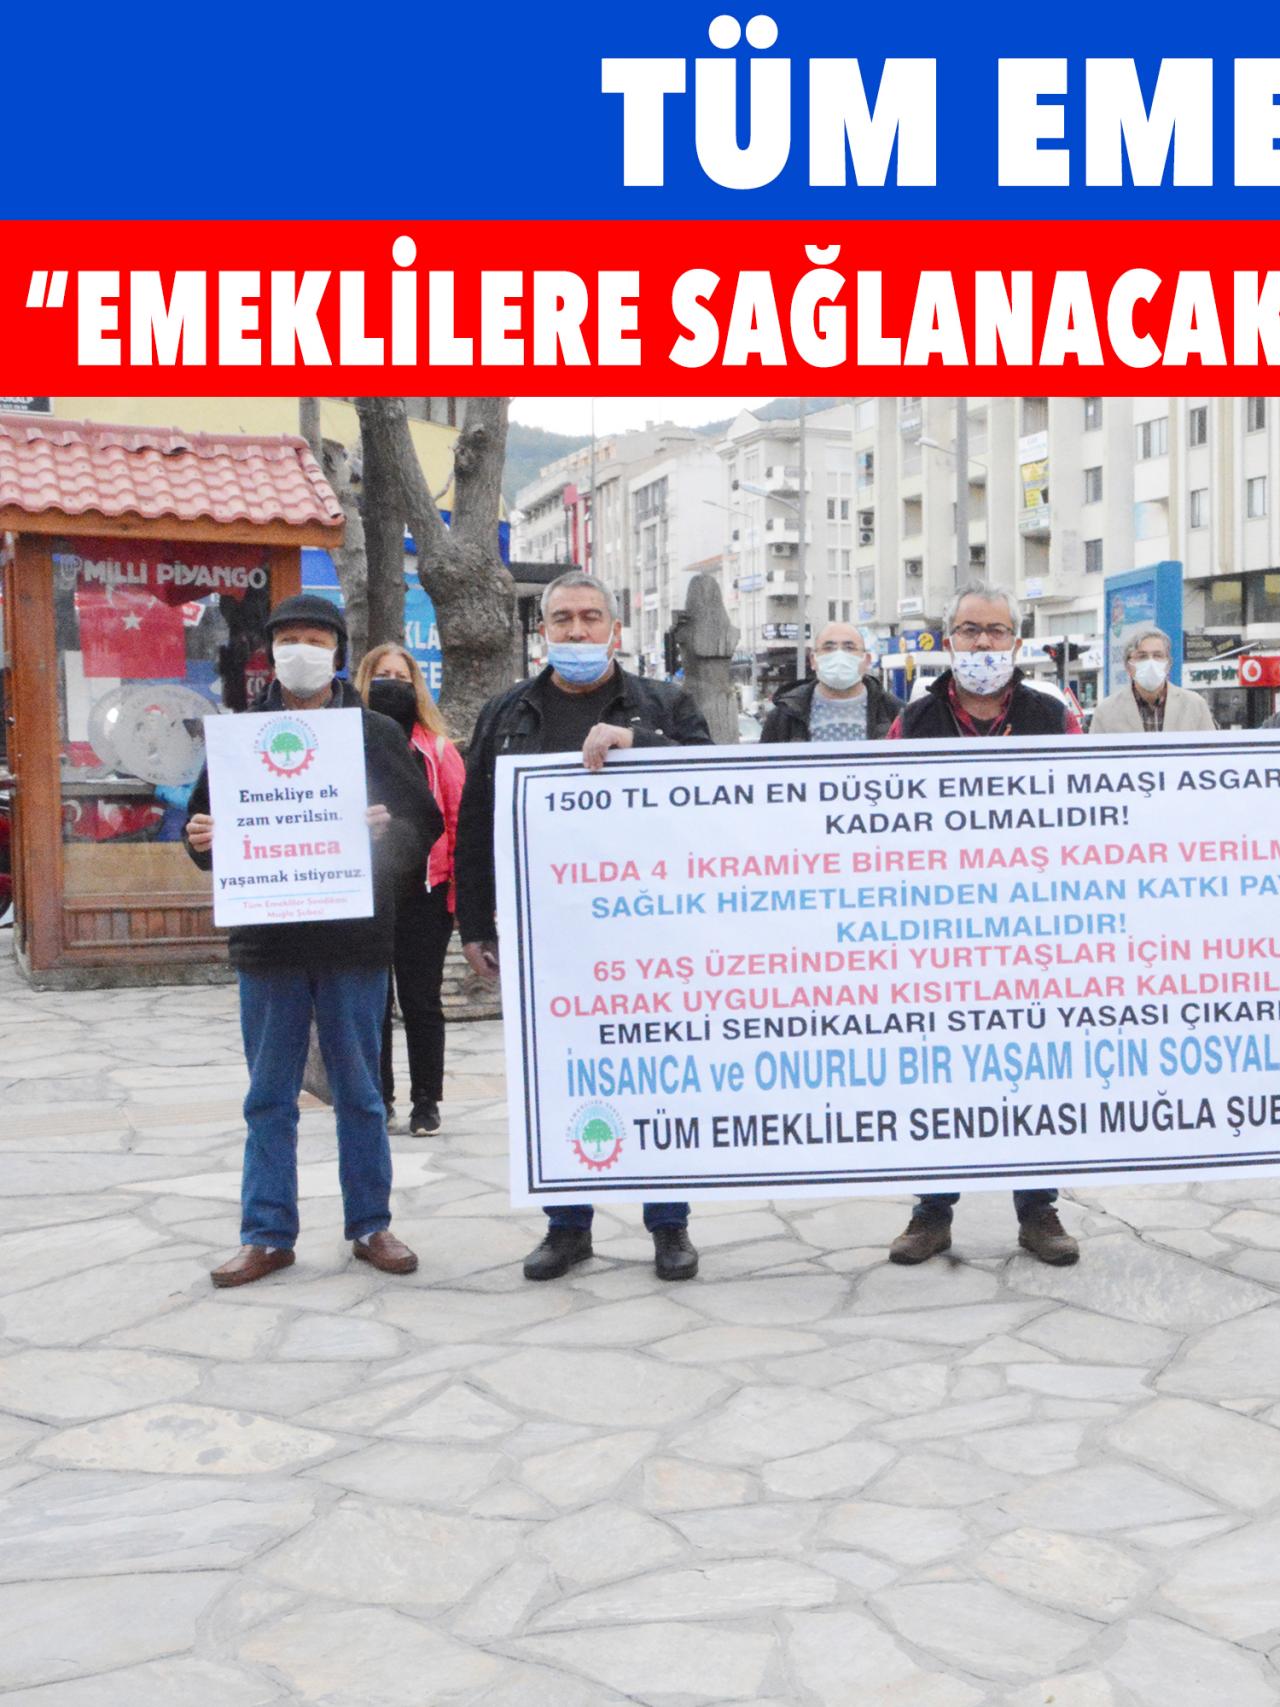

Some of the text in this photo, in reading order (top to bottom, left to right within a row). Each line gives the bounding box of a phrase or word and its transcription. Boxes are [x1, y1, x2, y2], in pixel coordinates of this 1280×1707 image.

[84, 558, 267, 589] MİLLİ PİYANGO
[239, 784, 338, 804] Emekliye ek
[545, 789, 612, 811] 1500
[623, 788, 658, 809] TL
[669, 783, 753, 807] OLAN
[767, 782, 806, 804] EN
[819, 774, 926, 806] DÜŞÜK
[939, 768, 1054, 798] EMEKLİ
[1067, 771, 1165, 798] MAAŞI
[236, 809, 342, 827] zam verilsin.
[826, 805, 1129, 835] KADAR OLMALIDIR!
[243, 834, 341, 860] İnsanca
[551, 860, 641, 885] YILDA
[651, 860, 667, 880] 4
[687, 848, 840, 879] İKRAMİYE
[853, 845, 947, 873] BİRER
[960, 846, 1049, 873] MAAŞ
[1061, 842, 1168, 866] KADAR
[220, 868, 366, 890] yaşamak istiyoruz.
[592, 889, 705, 919] SAĞLIK
[717, 878, 997, 914] HİZMETLERİNDEN
[1009, 878, 1126, 902] ALINAN
[1138, 875, 1228, 898] KATKI
[837, 913, 1127, 942] KALDIRILMALIDIR!
[594, 960, 625, 981] 65
[636, 956, 694, 986] YAŞ
[706, 943, 898, 977] ÜZERİNDEKİ
[909, 941, 1116, 970] YURTTAŞLAR
[1128, 935, 1191, 968] İÇİN
[551, 993, 671, 1018] OLARAK
[683, 985, 878, 1013] UYGULANAN
[890, 975, 1124, 1004] KISITLAMALAR
[600, 1013, 711, 1044] EMEKLİ
[723, 1009, 935, 1040] SENDİKALARI
[948, 1002, 1045, 1032] STATÜ
[1057, 1003, 1168, 1028] YASASI
[567, 1048, 701, 1097] İNSANCA
[711, 1061, 744, 1092] ve
[755, 1048, 886, 1090] ONURLU
[899, 1034, 951, 1084] BİR
[963, 1041, 1072, 1093] YAŞAM
[1084, 1027, 1147, 1089] İÇİN
[1159, 1033, 1280, 1078] SOSYAL
[634, 1109, 699, 1151] TÜM
[712, 1102, 898, 1149] EMEKLİLER
[909, 1096, 1086, 1142] SENDİKASI
[1100, 1089, 1216, 1133] MUĞLA
